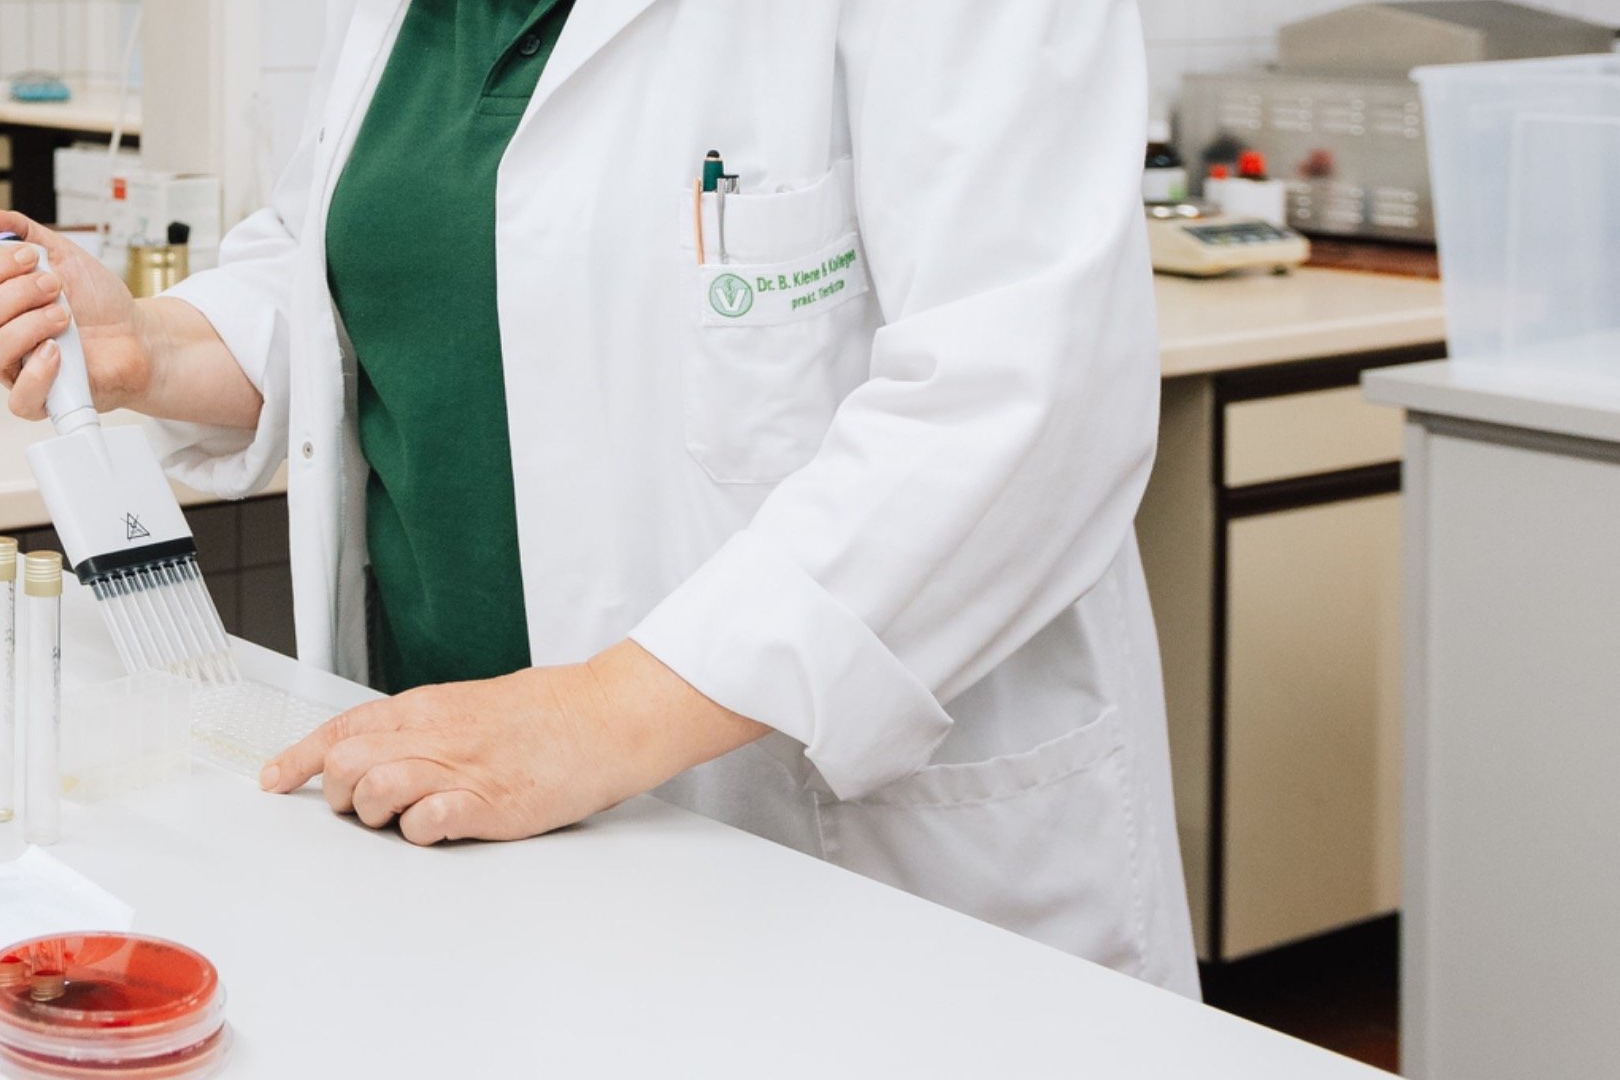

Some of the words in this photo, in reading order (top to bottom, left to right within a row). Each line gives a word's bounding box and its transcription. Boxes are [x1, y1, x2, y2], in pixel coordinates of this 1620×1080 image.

[756, 276, 776, 293] Dr.
[778, 274, 792, 291] B.
[793, 269, 821, 288] Kiene
